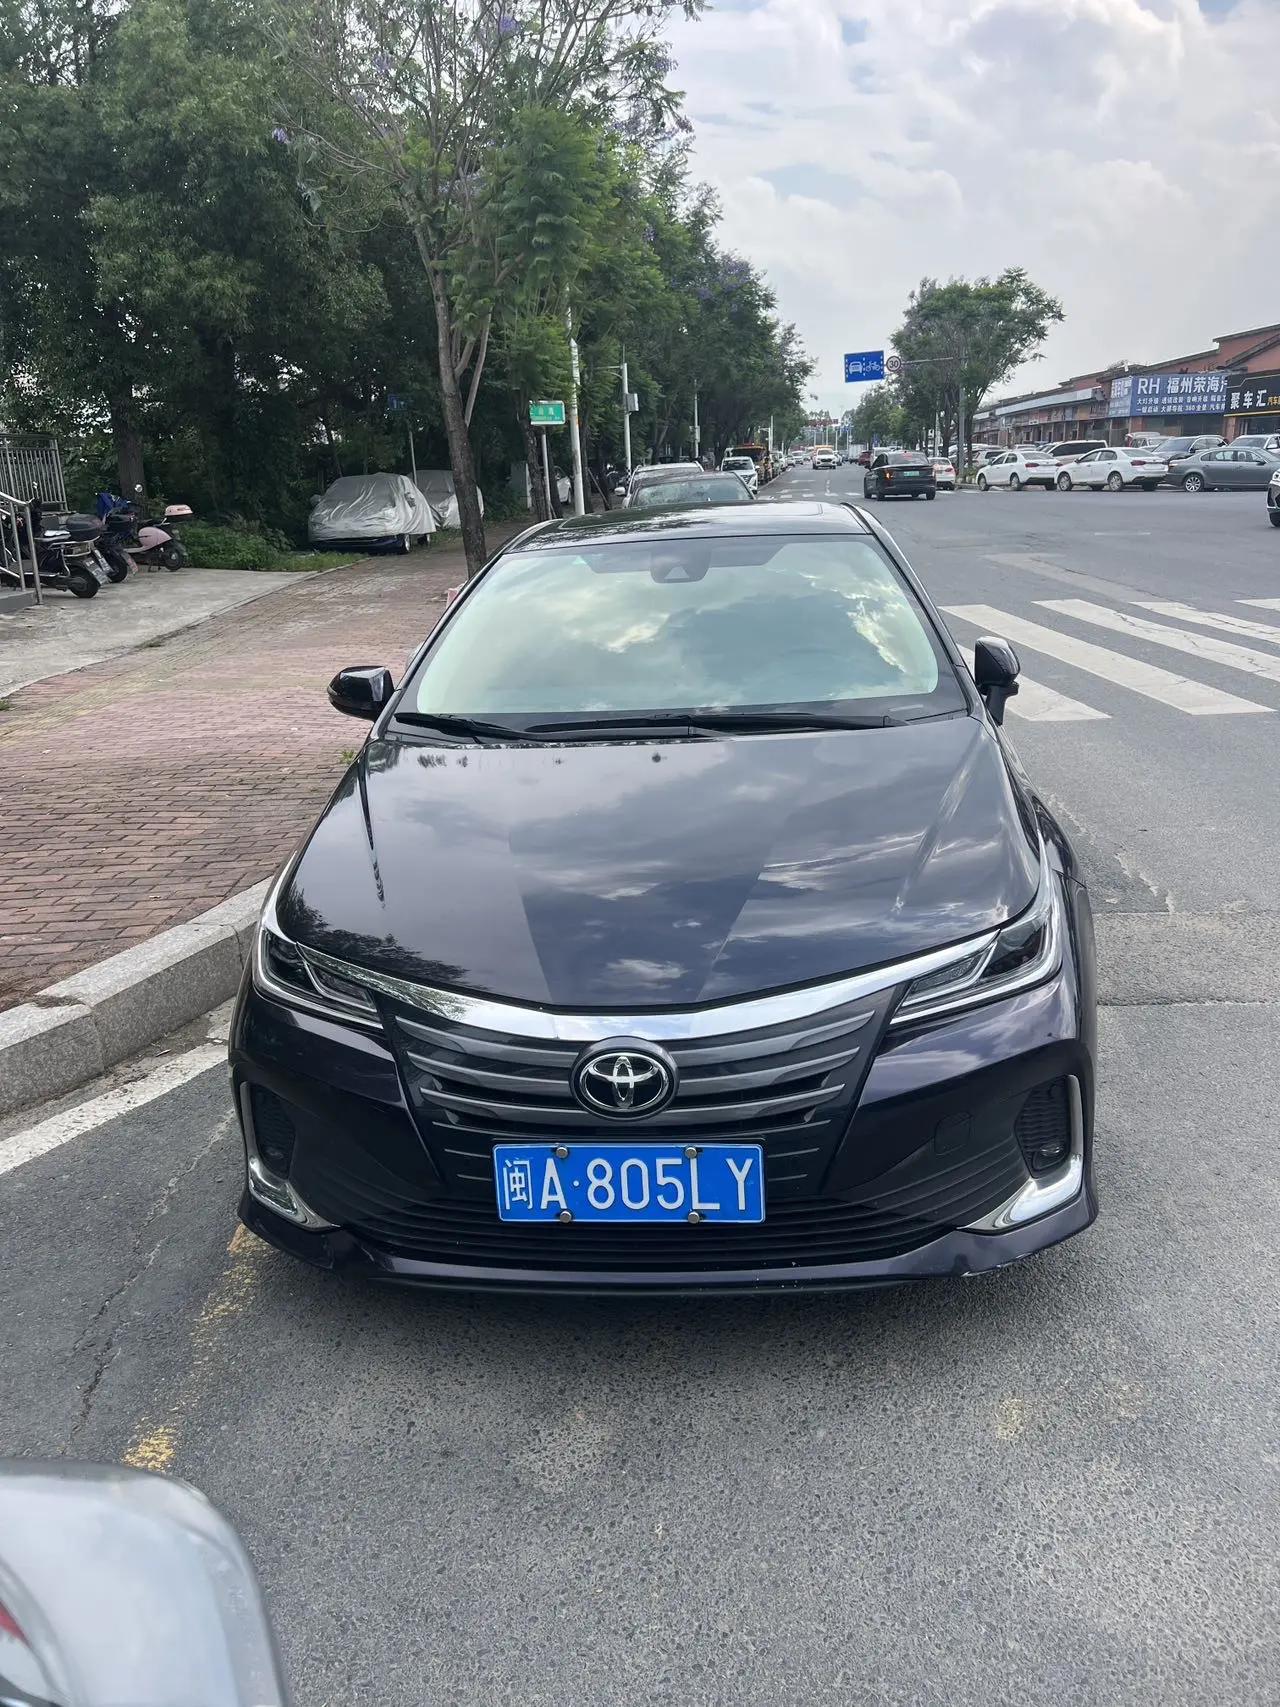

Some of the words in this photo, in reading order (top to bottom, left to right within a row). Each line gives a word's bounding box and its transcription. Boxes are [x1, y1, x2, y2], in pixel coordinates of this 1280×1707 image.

[1138, 378, 1160, 394] RH
[1230, 389, 1267, 410] 聚车汇
[502, 1157, 754, 1211] 闽A·805LY
